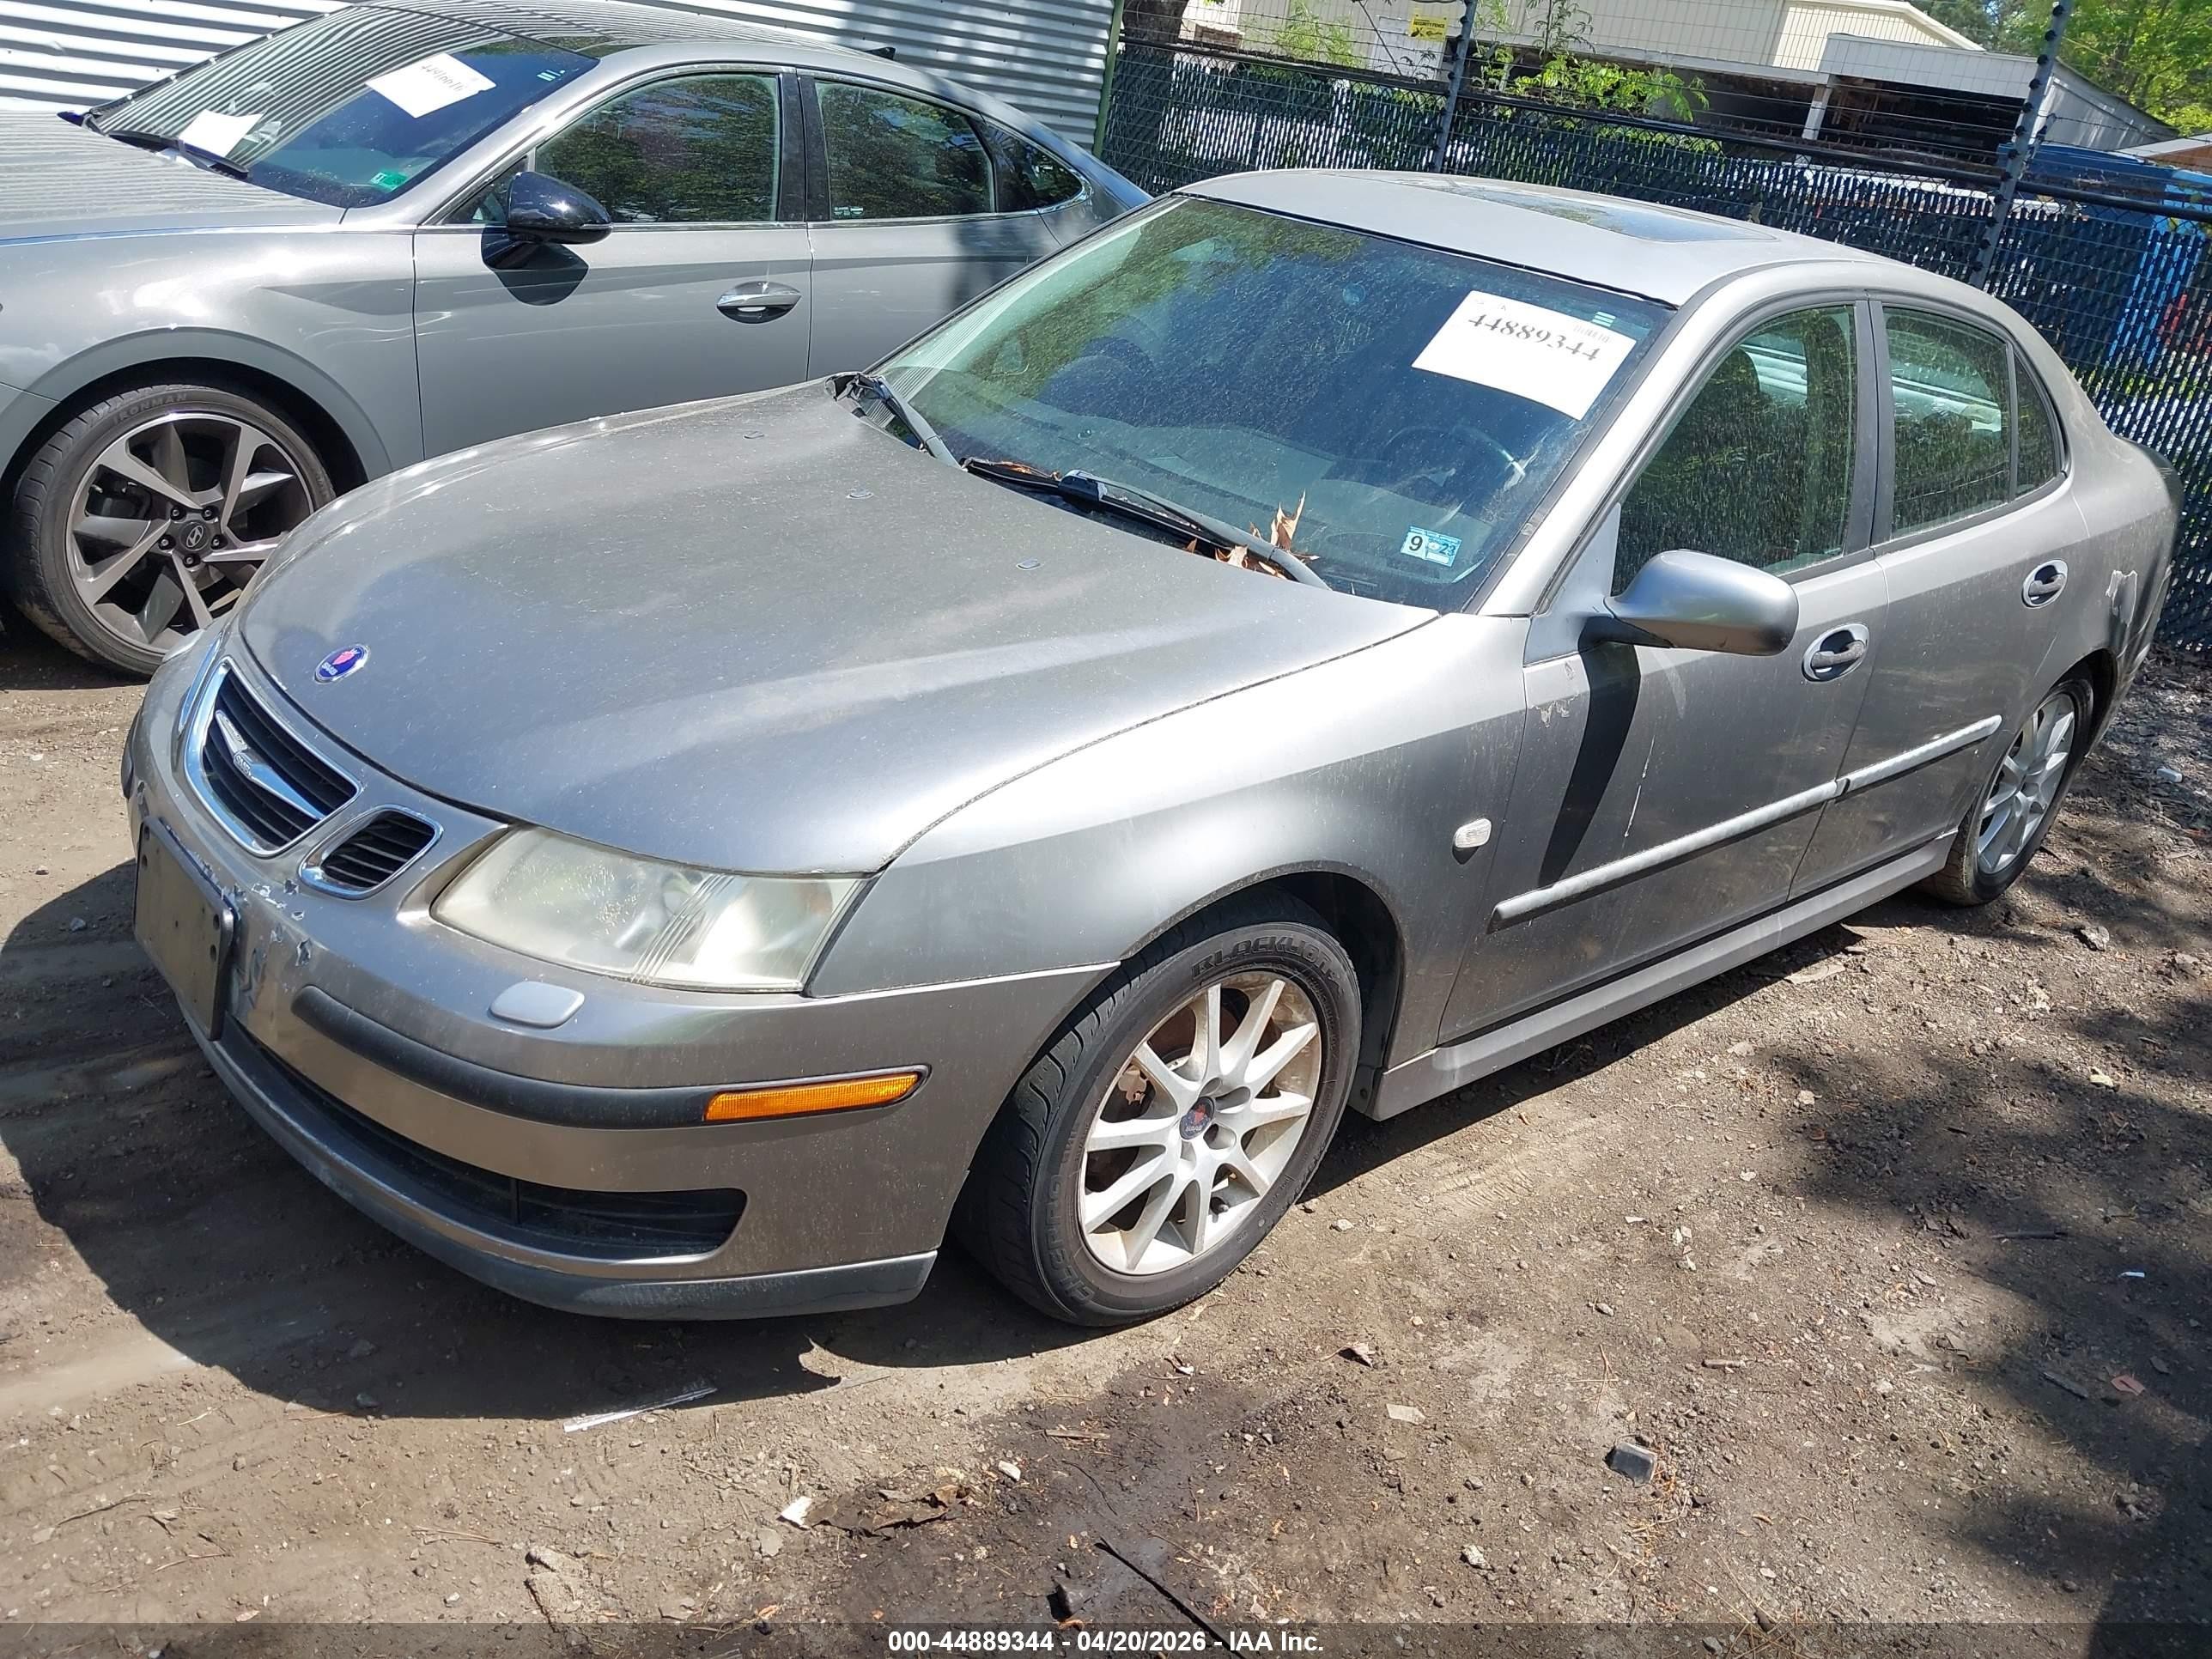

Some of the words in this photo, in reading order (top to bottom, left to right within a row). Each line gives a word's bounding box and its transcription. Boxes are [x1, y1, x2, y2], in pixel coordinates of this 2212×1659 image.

[1468, 314, 1601, 361] 44889344
[112, 393, 187, 423] IRONMAN
[1409, 535, 1423, 551] 9
